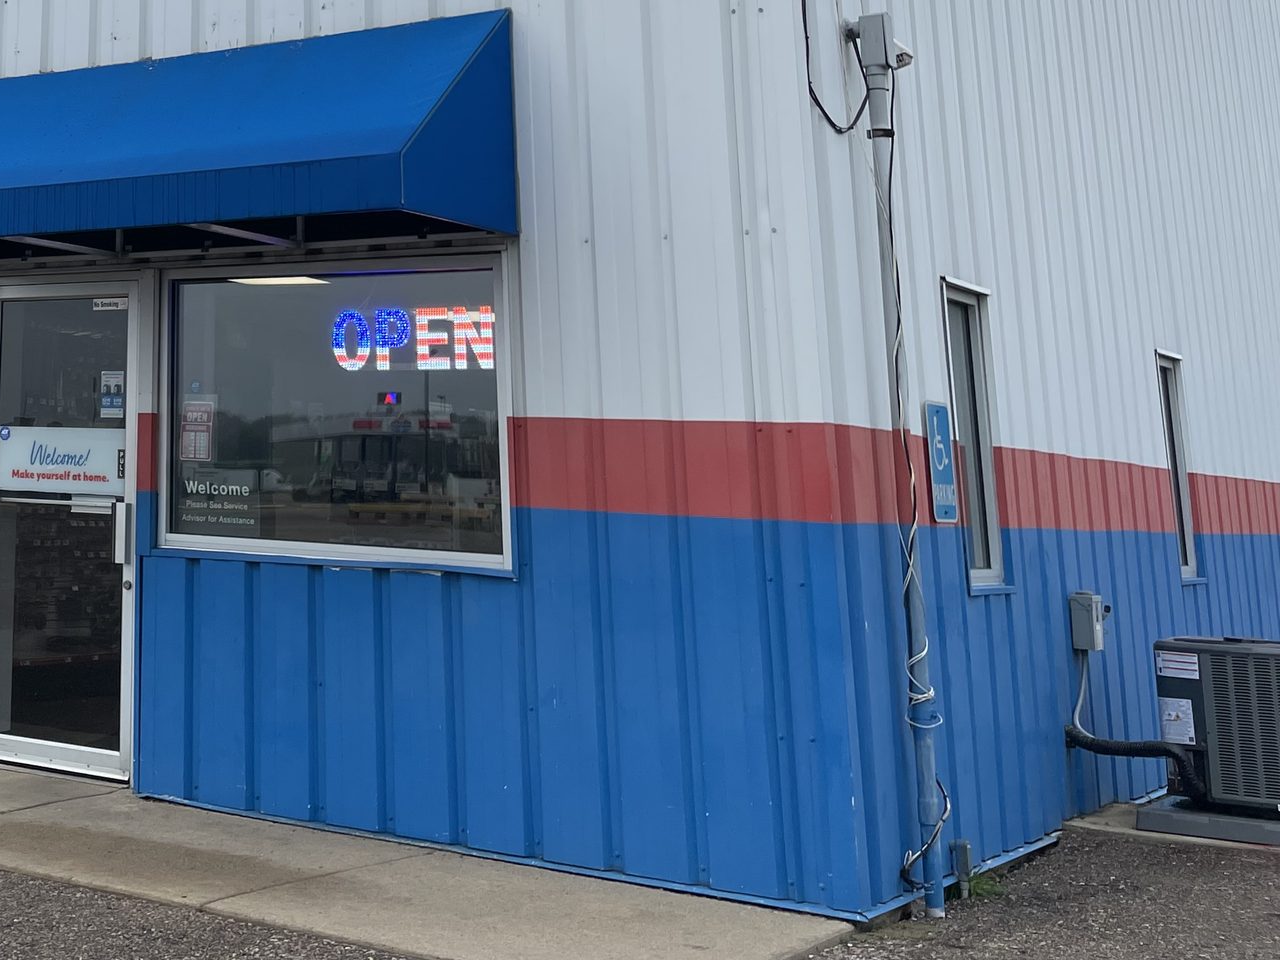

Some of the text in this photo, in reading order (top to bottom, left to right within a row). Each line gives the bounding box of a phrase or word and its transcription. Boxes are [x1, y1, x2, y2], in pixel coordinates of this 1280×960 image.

[331, 305, 495, 371] OPEN
[186, 412, 208, 423] OPEN
[30, 440, 91, 467] Welcome!
[11, 469, 109, 482] Make yourself at home.
[184, 479, 250, 497] Welcome
[185, 499, 248, 511] Please See Service
[182, 513, 255, 525] Advisor for Assistance
